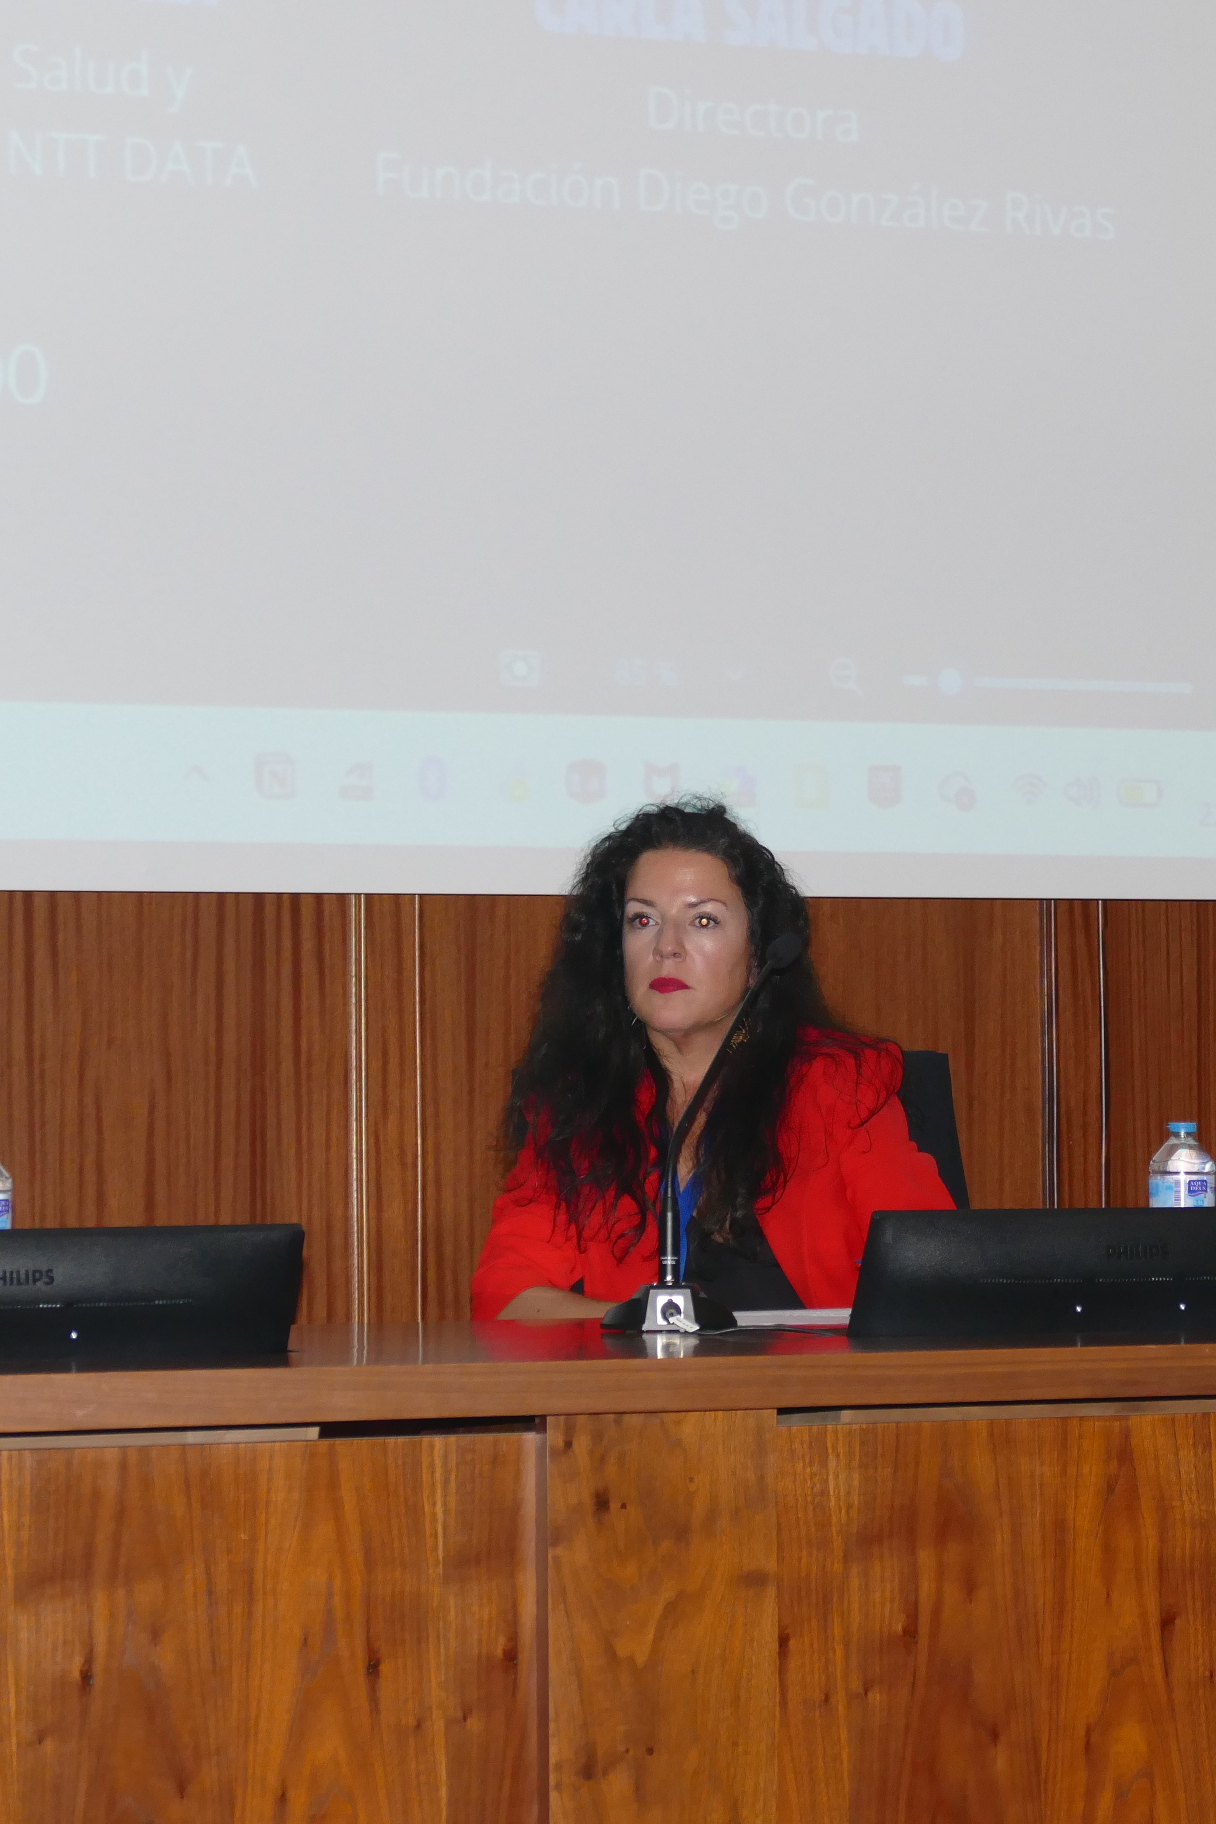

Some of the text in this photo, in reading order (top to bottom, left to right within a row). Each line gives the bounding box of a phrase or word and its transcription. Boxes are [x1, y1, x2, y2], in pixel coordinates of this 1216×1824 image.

[533, 0, 966, 62] CARLA SALGADO
[11, 43, 193, 113] Salud y
[647, 86, 860, 142] Directora
[7, 130, 258, 189] NTT DATA
[375, 151, 1117, 241] Fundación Diego González Rivas
